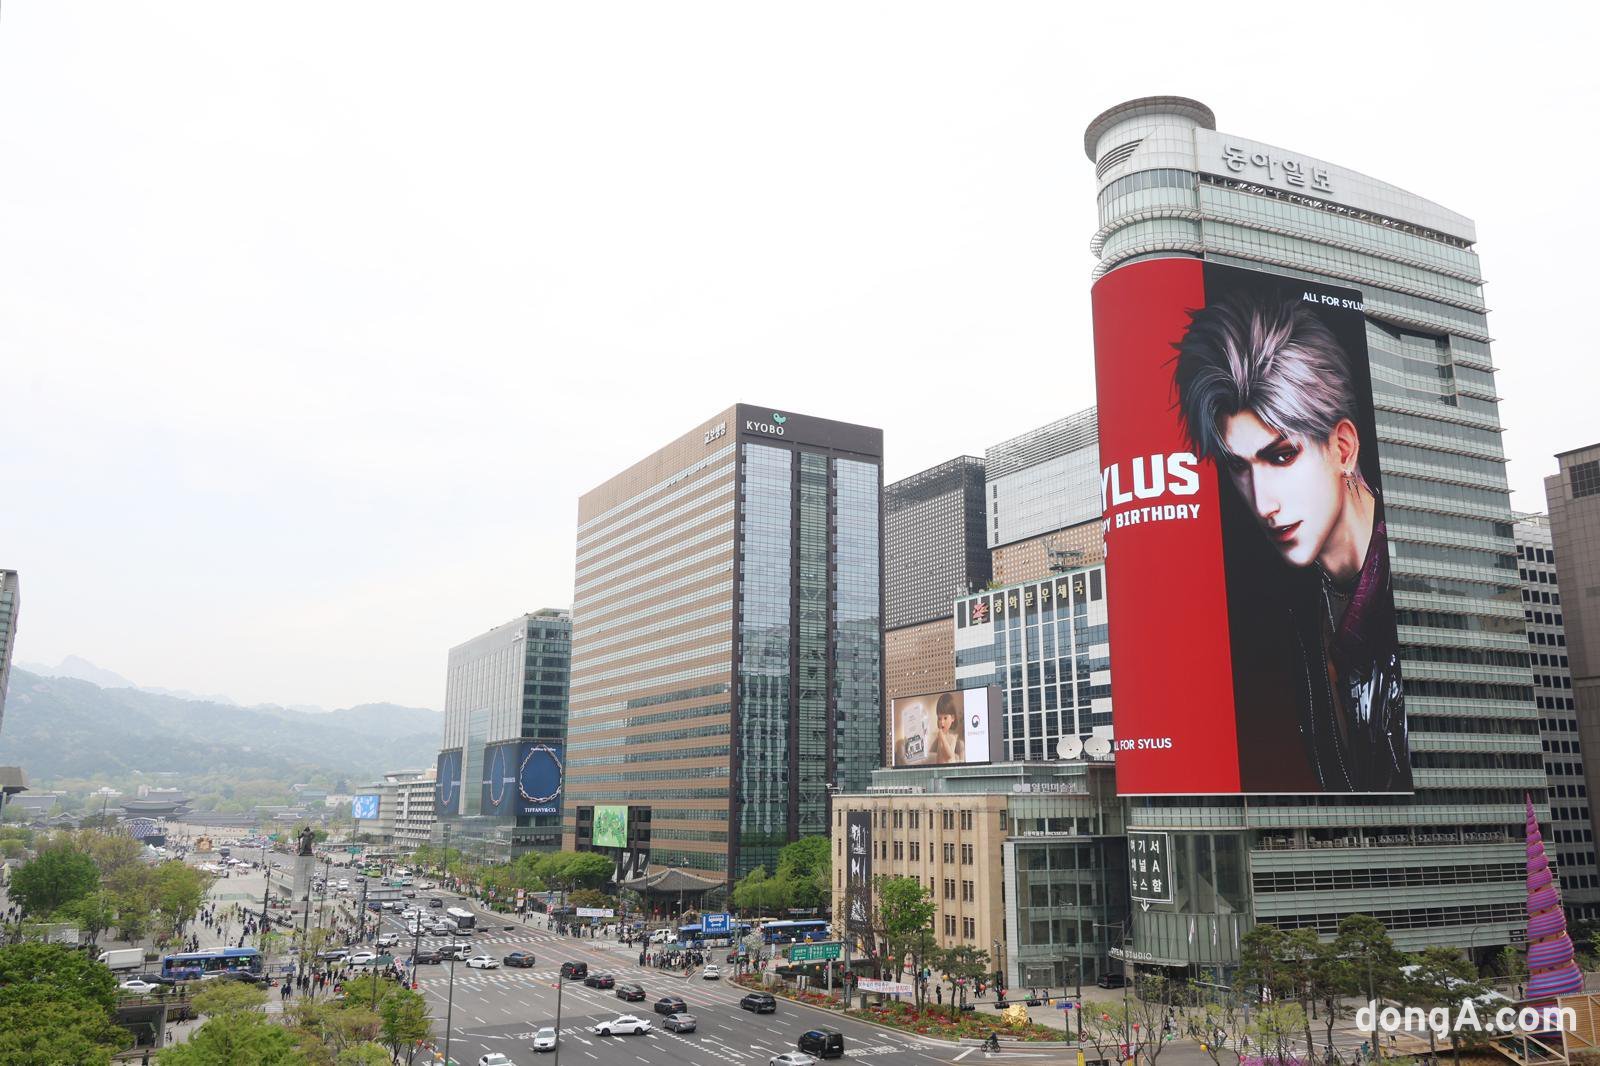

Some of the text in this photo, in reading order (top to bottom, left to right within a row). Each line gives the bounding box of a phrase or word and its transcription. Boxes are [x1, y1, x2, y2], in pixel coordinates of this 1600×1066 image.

[1222, 144, 1335, 194] 동아일보
[1303, 292, 1319, 303] ALL
[1321, 295, 1339, 307] FOR
[746, 421, 784, 435] KYOBO
[1115, 504, 1200, 529] BIRTHDAY
[994, 579, 1084, 614] 광화문우체국
[1120, 739, 1135, 750] FOR
[1137, 738, 1172, 749] SYLUS
[1124, 950, 1152, 960] STUDIO
